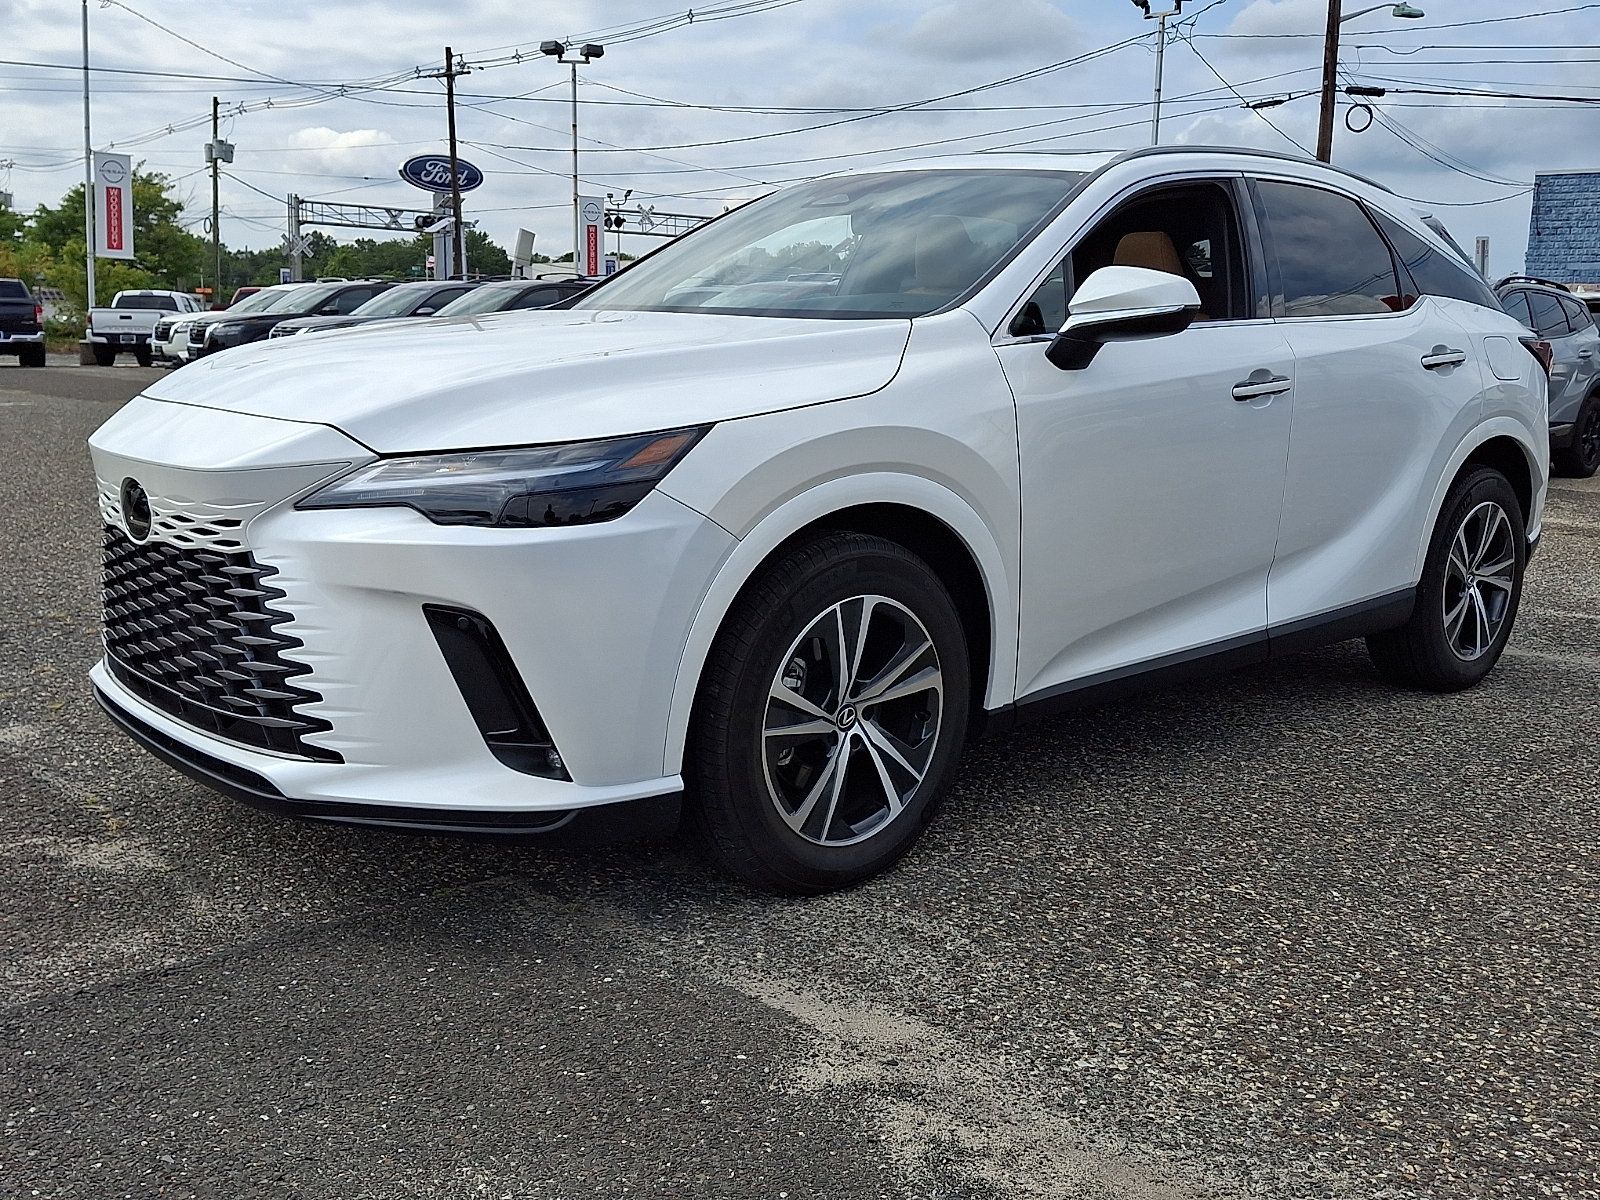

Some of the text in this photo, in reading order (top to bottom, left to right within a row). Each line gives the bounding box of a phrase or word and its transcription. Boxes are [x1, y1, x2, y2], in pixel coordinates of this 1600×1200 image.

[420, 160, 469, 186] Ford
[109, 188, 118, 249] WOODBURY
[588, 226, 597, 276] WOODBURY
